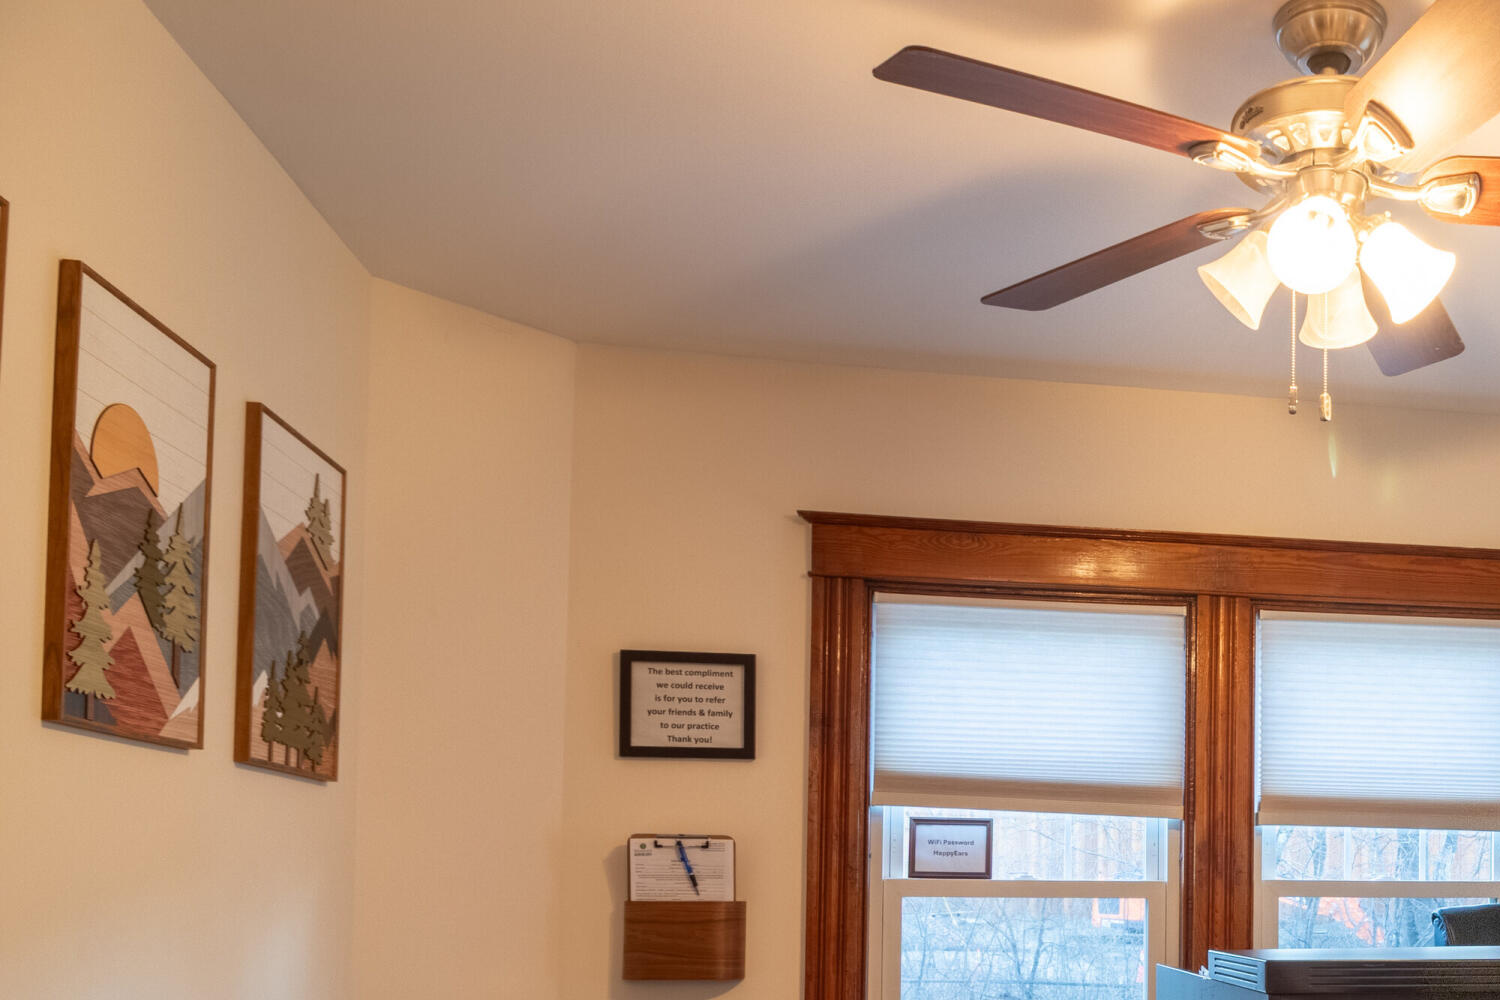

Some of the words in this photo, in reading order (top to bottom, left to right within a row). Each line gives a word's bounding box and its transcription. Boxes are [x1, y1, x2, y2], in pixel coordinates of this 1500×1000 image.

[648, 667, 663, 675] The
[665, 668, 683, 676] best
[684, 669, 733, 679] compliment
[670, 682, 693, 690] could
[695, 683, 725, 691] receive
[654, 694, 662, 702] is
[664, 694, 676, 702] for
[678, 696, 693, 704] you
[705, 696, 726, 704] refer
[647, 709, 666, 717] your
[668, 708, 697, 717] friends
[699, 709, 706, 717] &
[707, 709, 733, 719] family
[687, 722, 720, 732] practice
[667, 735, 692, 743] Thank
[694, 736, 713, 745] you!
